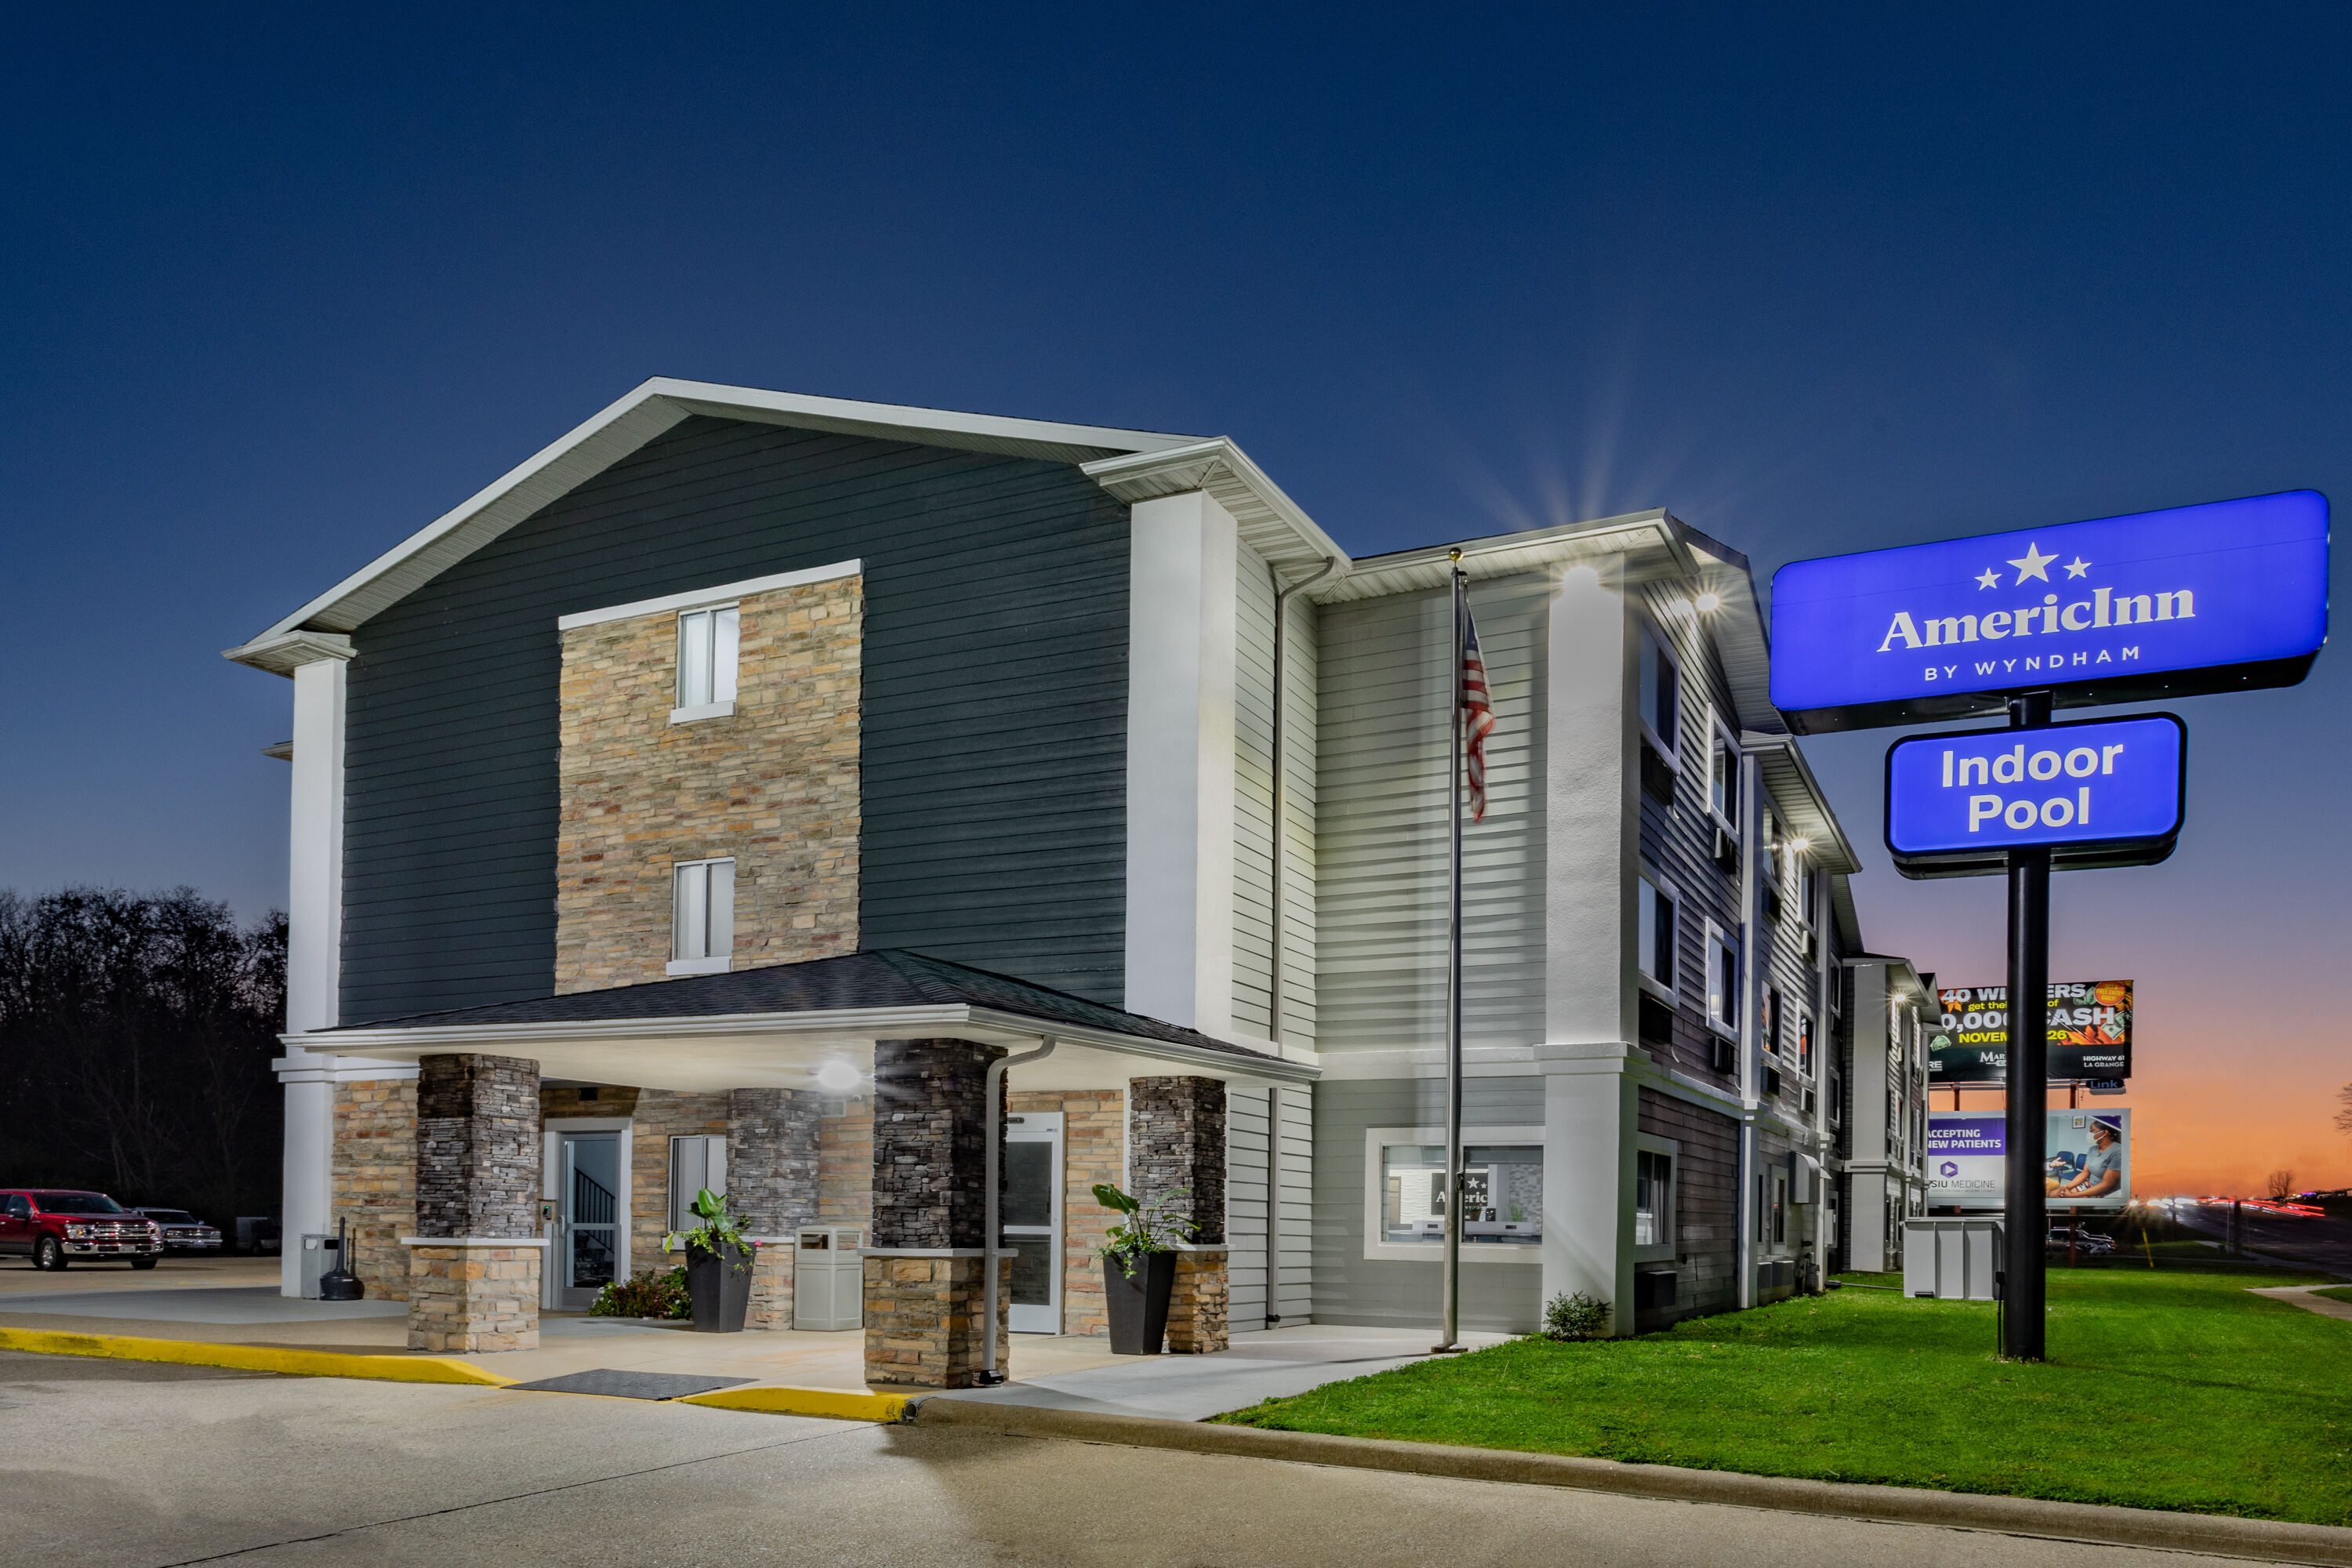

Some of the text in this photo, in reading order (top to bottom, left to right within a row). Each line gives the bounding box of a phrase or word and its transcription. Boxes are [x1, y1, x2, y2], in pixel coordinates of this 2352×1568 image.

[1876, 587, 2196, 652] AmericInn
[1925, 646, 2140, 681] BY WYNDHAM
[1942, 744, 2124, 788] Indoor
[1969, 786, 2091, 833] Pool
[1940, 984, 2086, 1003] 40 WIERS
[1968, 999, 2060, 1011] get thei of
[2047, 1007, 2114, 1026] ASH
[1958, 1029, 2067, 1044] NOVEM 26
[2090, 1080, 2118, 1089] Link
[1951, 1139, 2002, 1149] PATIENTS
[1951, 1180, 1995, 1189] MEDICINE
